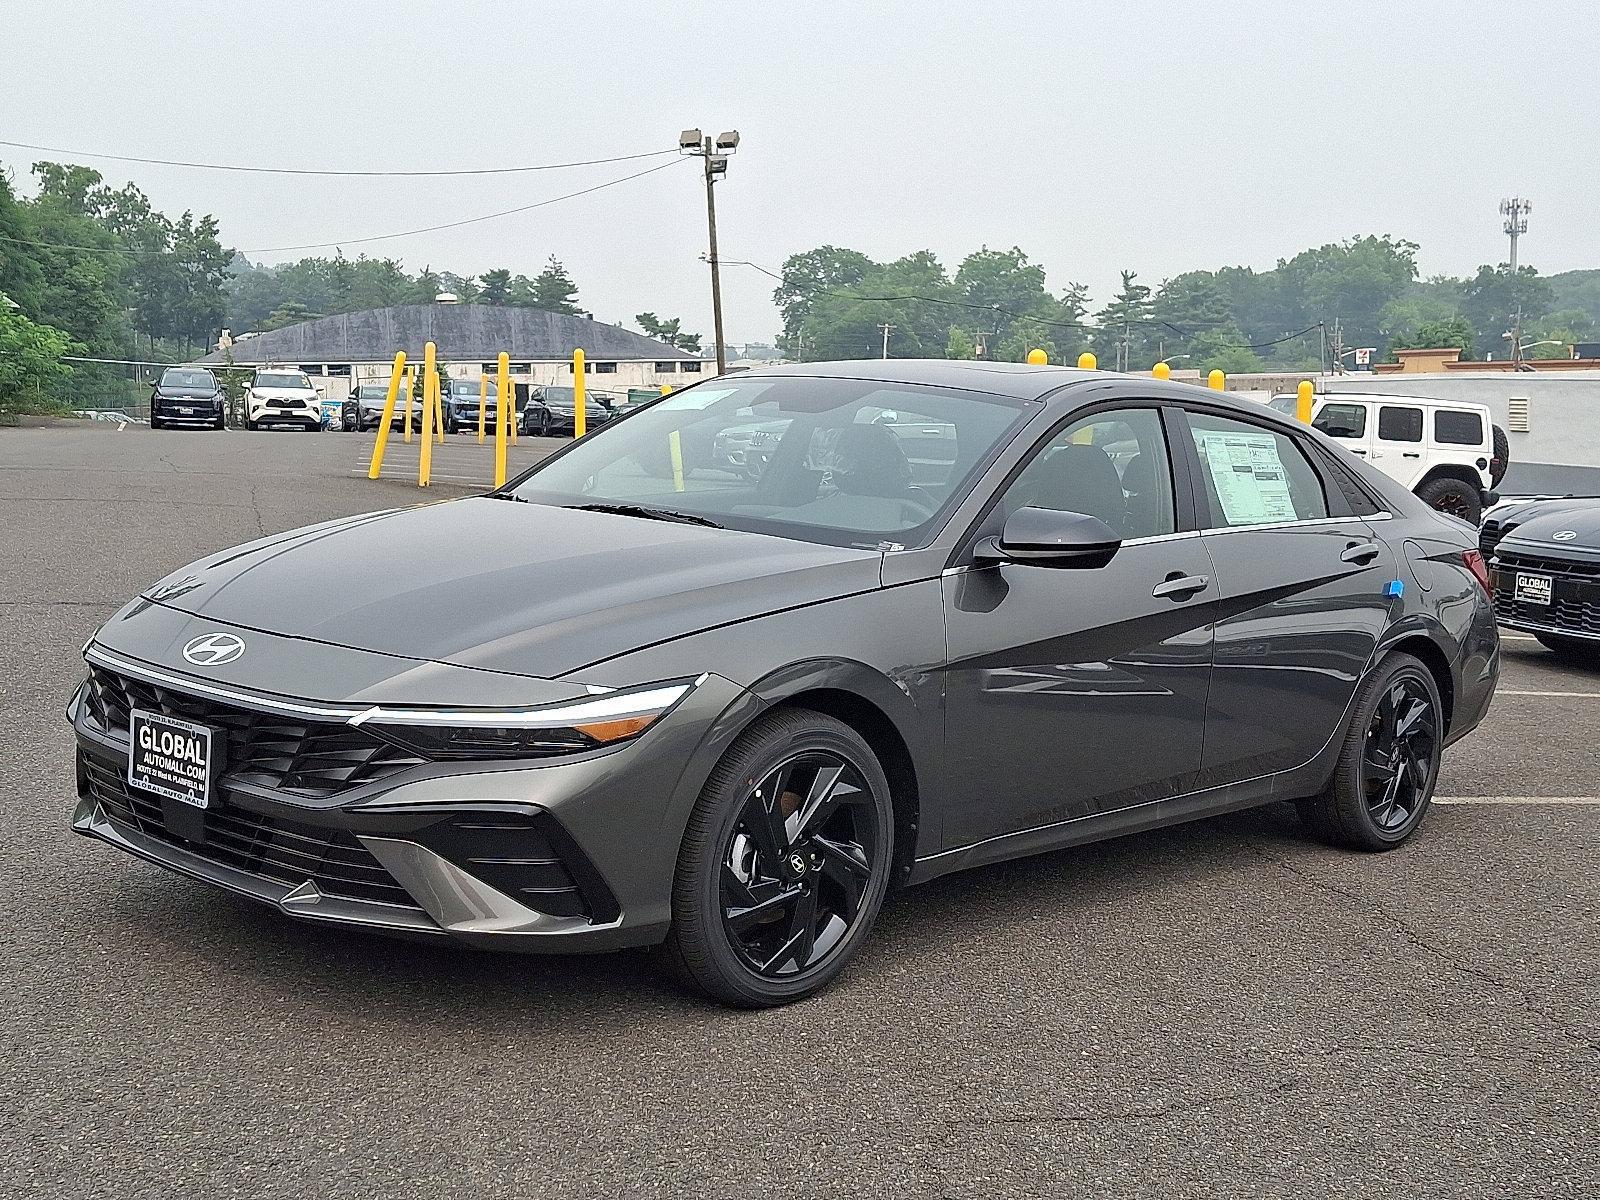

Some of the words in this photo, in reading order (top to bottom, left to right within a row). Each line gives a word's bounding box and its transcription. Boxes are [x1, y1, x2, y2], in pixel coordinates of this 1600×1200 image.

[1519, 576, 1550, 590] GLOBAL
[139, 725, 206, 766] GLOBAL
[136, 763, 151, 775] ROUTE
[151, 768, 157, 776] 22
[198, 782, 205, 791] NJ
[143, 752, 206, 781] AUTOMALL.COM
[131, 780, 161, 792] GLOBAL
[162, 789, 182, 799] AUTO
[184, 796, 204, 806] MALL
